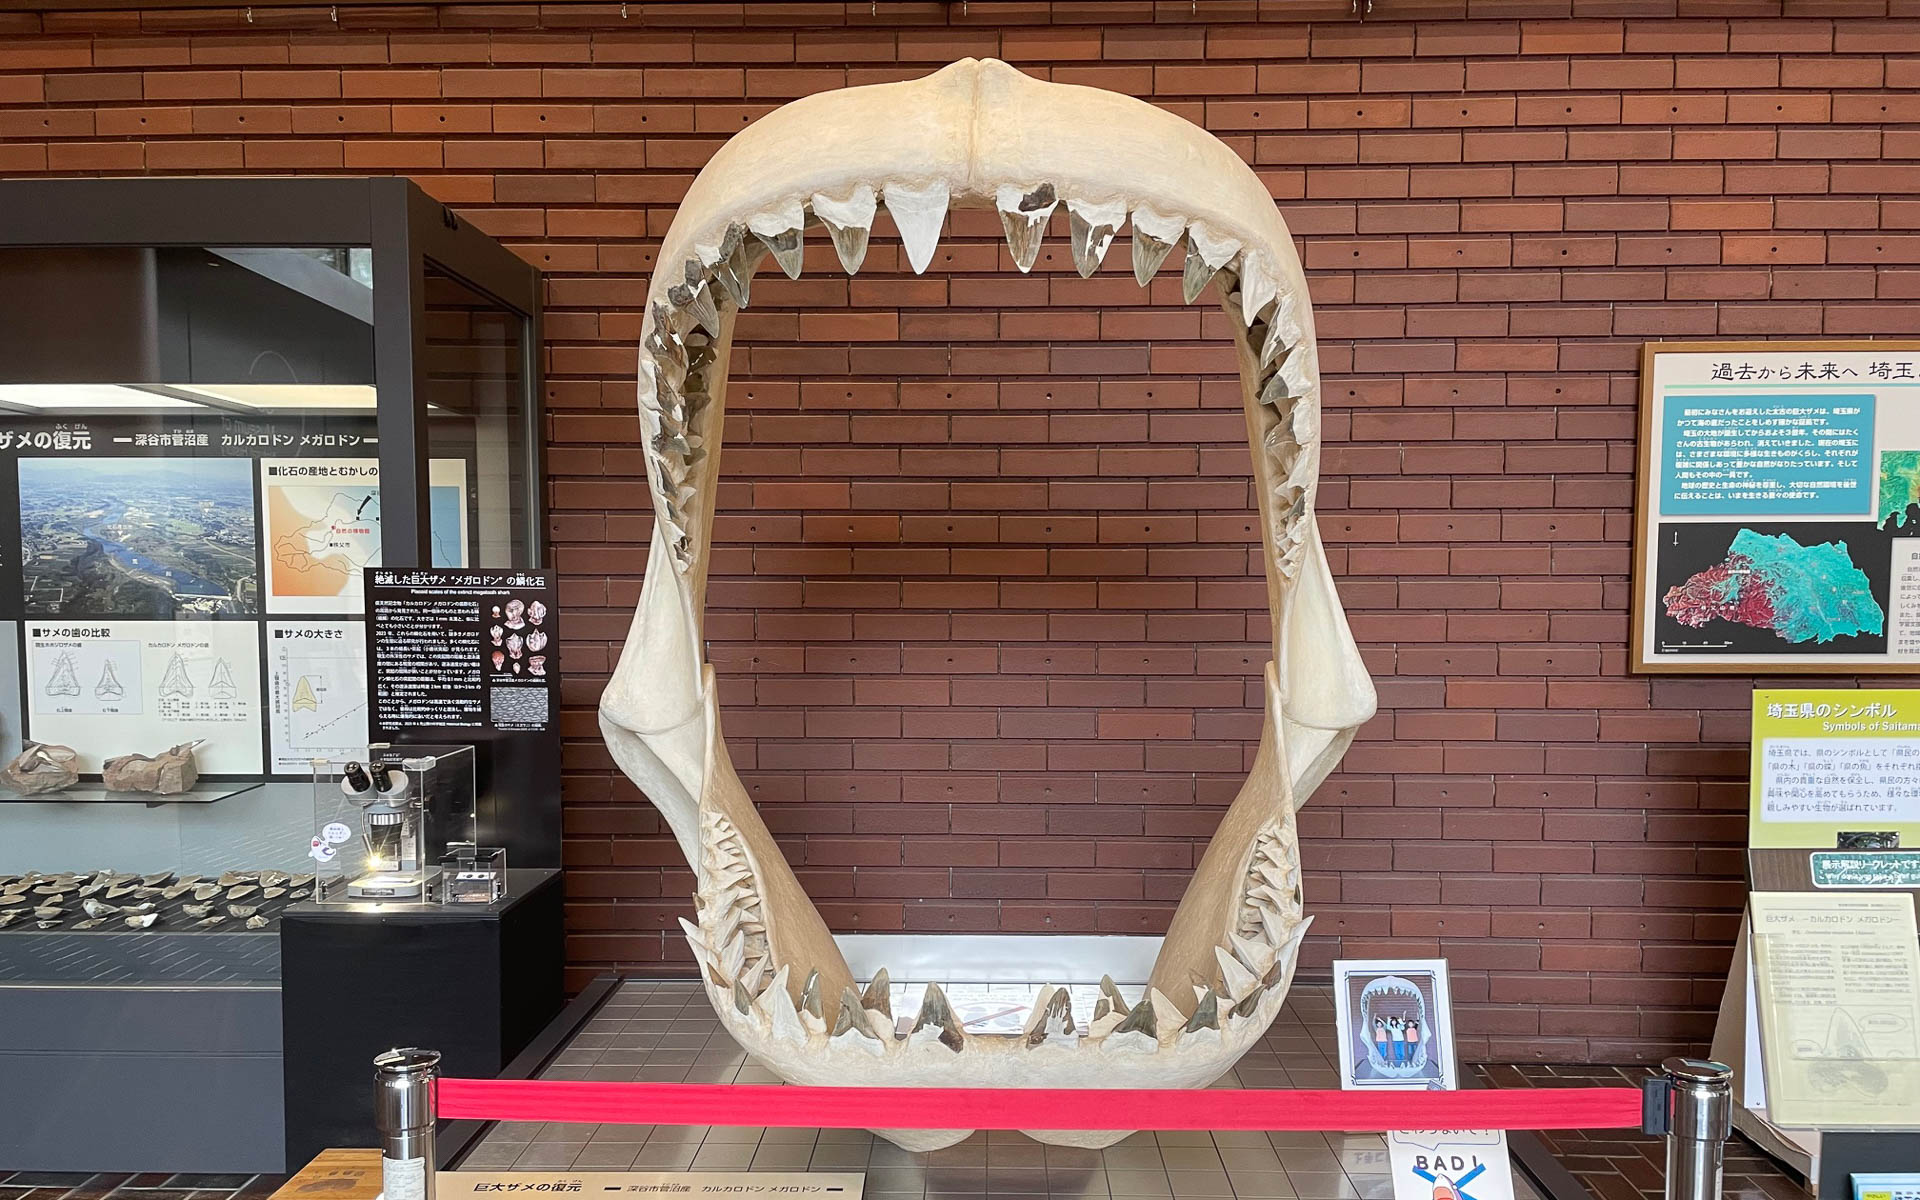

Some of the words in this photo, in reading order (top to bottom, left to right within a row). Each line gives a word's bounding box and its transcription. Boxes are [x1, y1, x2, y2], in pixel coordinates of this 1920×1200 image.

[1711, 362, 1858, 381] 過去から未来へ
[1869, 361, 1920, 380] 埼玉
[221, 434, 294, 446] カルカロドン
[300, 434, 361, 446] メガロドン
[374, 575, 447, 586] 絶滅した巨大ザメ
[42, 628, 111, 639] サメの歯の比較
[284, 629, 343, 639] サメの大きさ
[1767, 703, 1898, 719] 埼玉県のシンボル
[1823, 721, 1866, 733] Symbols
[1868, 721, 1880, 731] of
[473, 1182, 583, 1192] 巨大ザメの復元
[701, 1184, 765, 1192] カルカロドン
[769, 1184, 822, 1192] メガロドン
